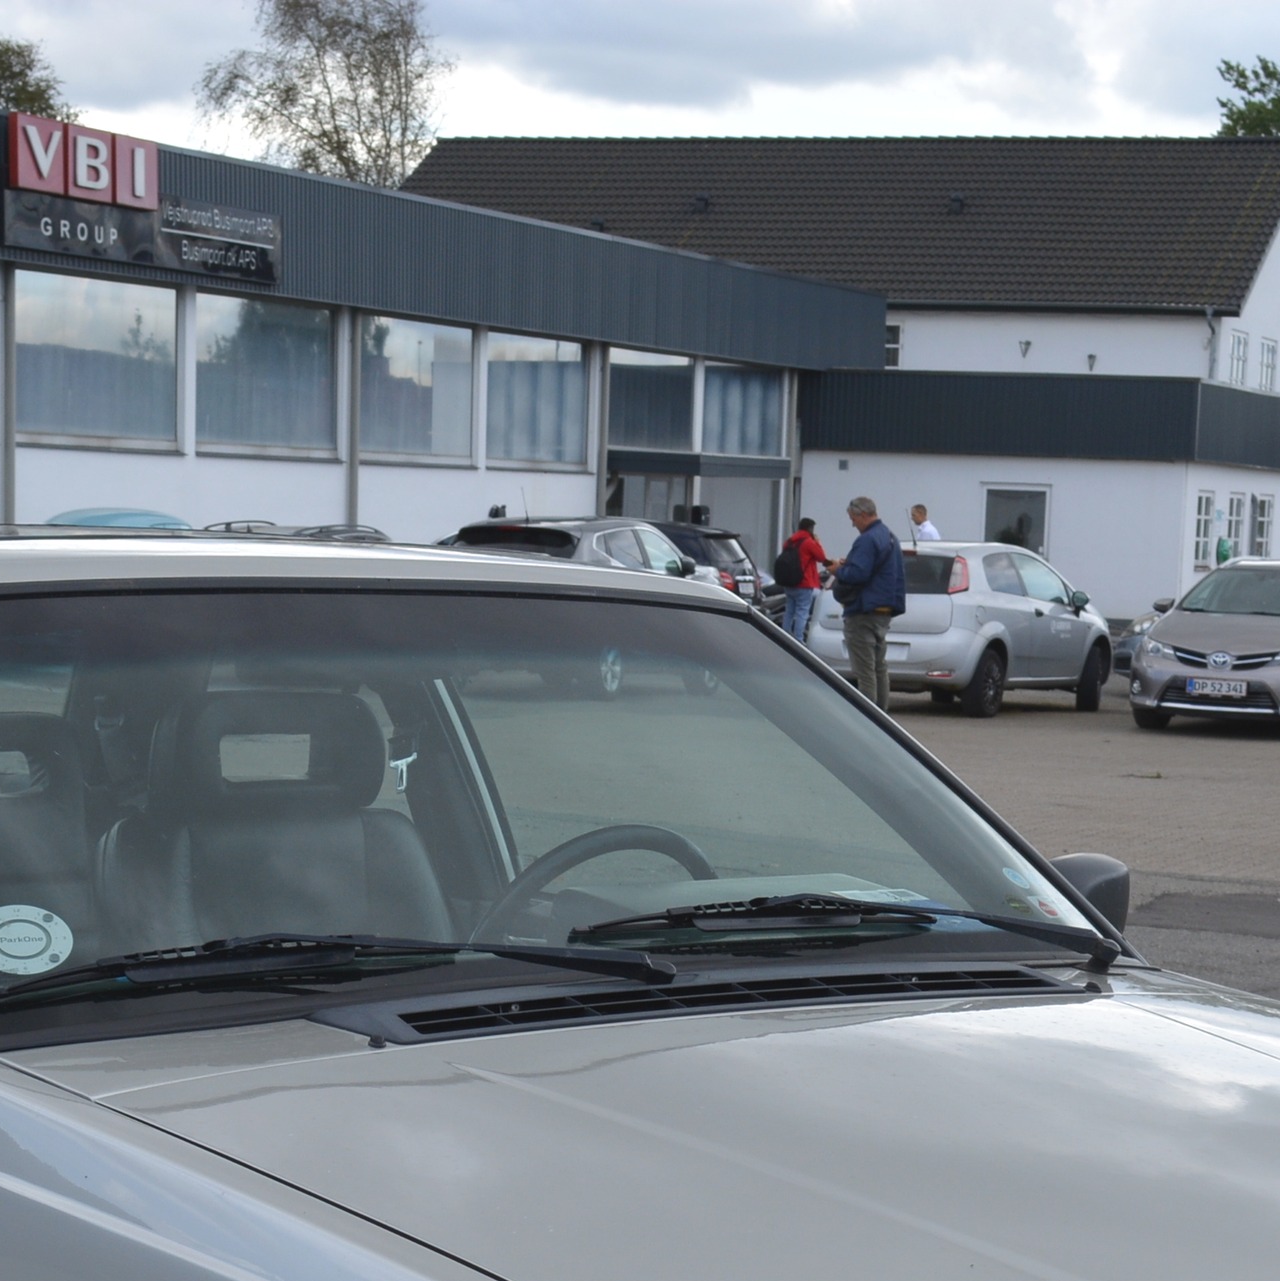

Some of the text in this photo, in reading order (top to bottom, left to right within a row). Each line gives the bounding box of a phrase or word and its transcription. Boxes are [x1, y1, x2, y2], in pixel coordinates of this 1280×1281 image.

[24, 124, 146, 198] VBI
[39, 216, 119, 245] GROUP
[238, 249, 257, 271] APS
[1194, 681, 1244, 694] DP 52 341
[0, 936, 44, 944] ParkOne
